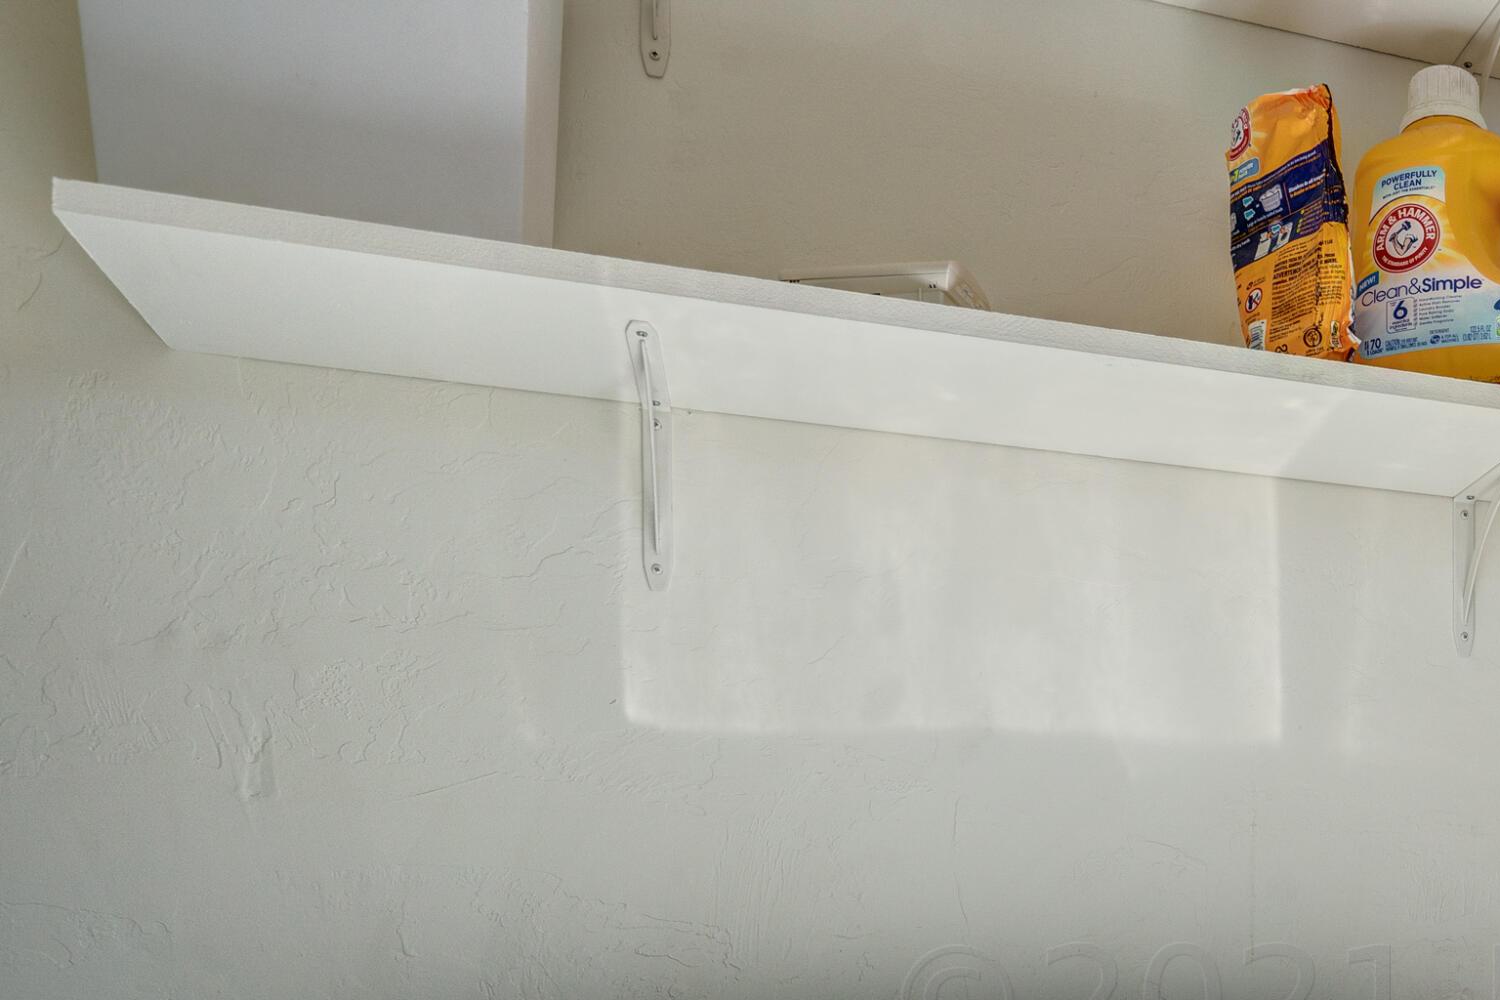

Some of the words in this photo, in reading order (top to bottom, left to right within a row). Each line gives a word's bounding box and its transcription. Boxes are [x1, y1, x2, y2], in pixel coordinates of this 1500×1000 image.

[1381, 170, 1437, 188] POWERFULLY
[1393, 179, 1422, 190] CLEAN
[1376, 224, 1391, 251] ARM
[1387, 215, 1398, 226] &
[1397, 207, 1435, 240] HAMMER
[1393, 299, 1409, 320] 6
[1370, 338, 1382, 350] 70
